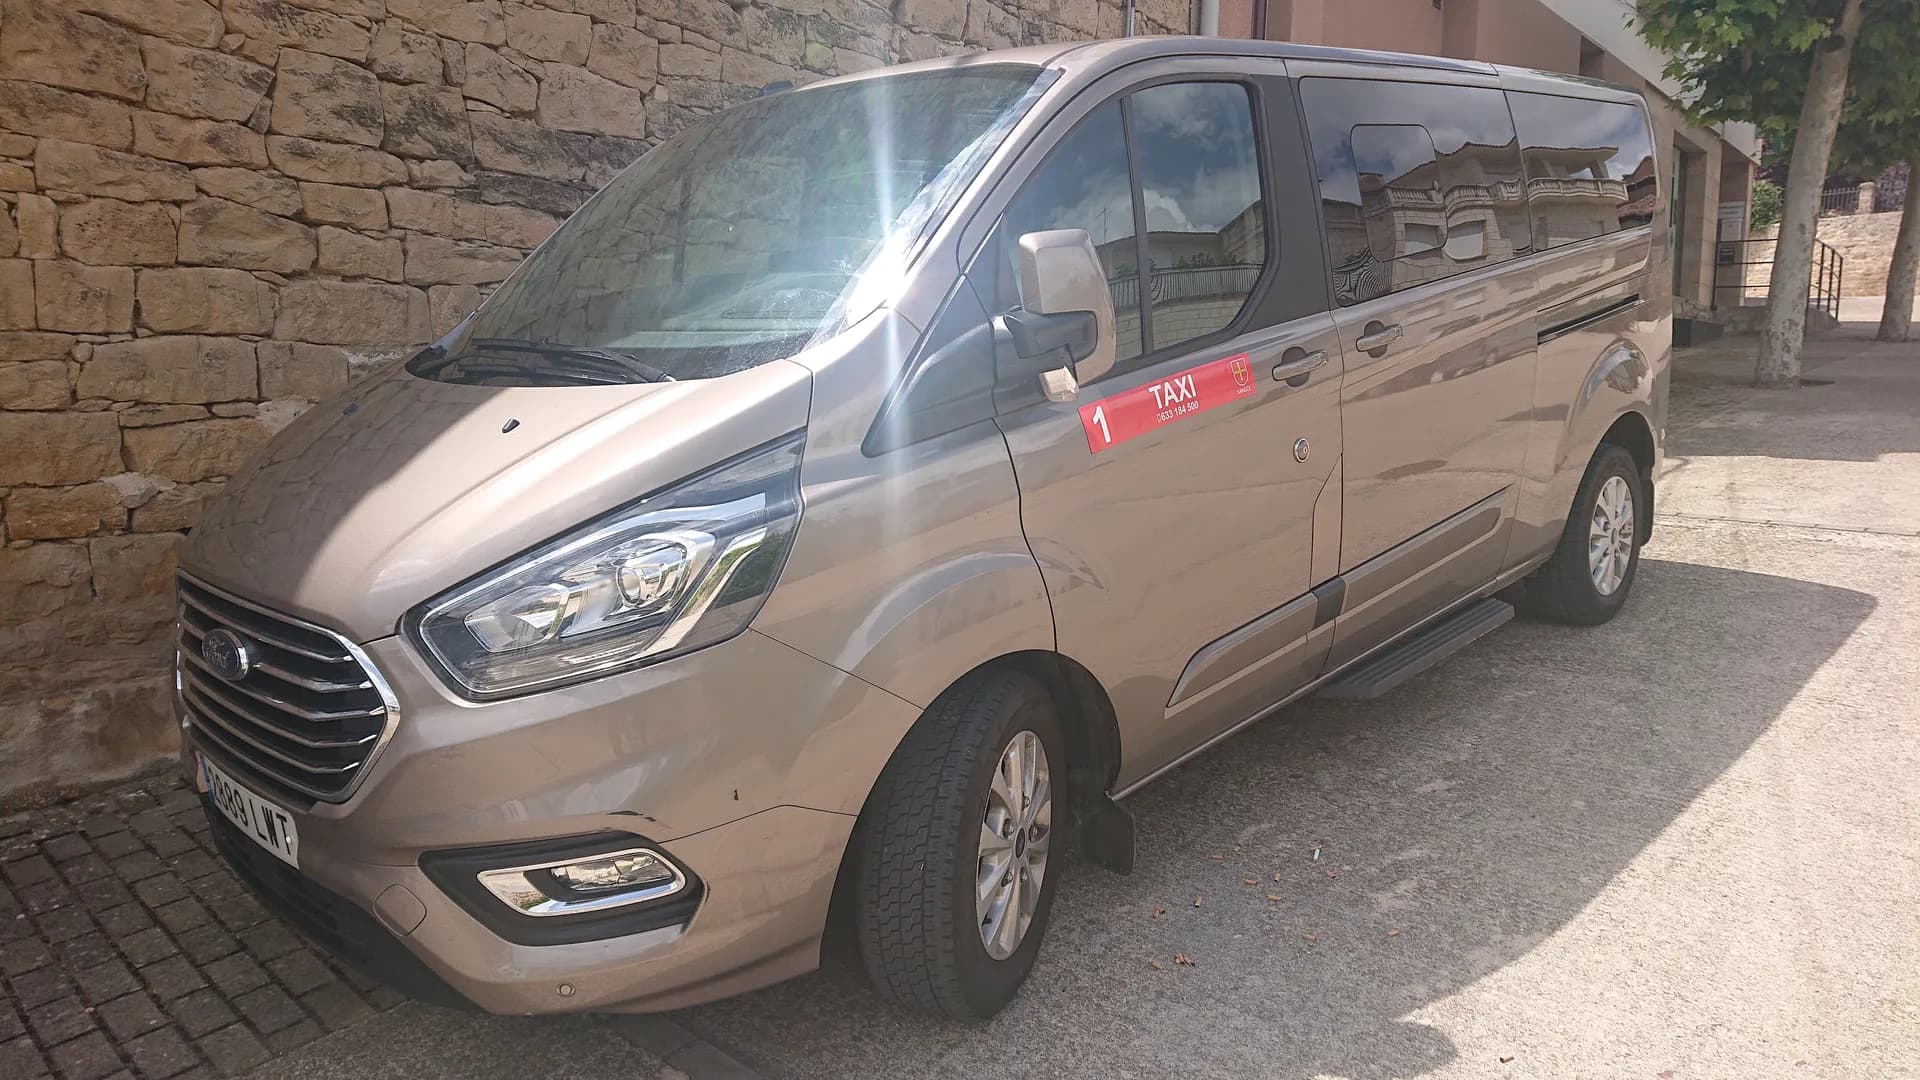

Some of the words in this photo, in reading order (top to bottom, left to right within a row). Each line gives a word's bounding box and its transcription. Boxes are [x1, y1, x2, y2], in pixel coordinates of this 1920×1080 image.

[1148, 374, 1197, 409] TAXI
[1092, 405, 1112, 444] 1
[1160, 410, 1174, 421] 633
[1174, 404, 1187, 416] 184
[1187, 400, 1199, 412] 500
[249, 798, 291, 856] LWT
